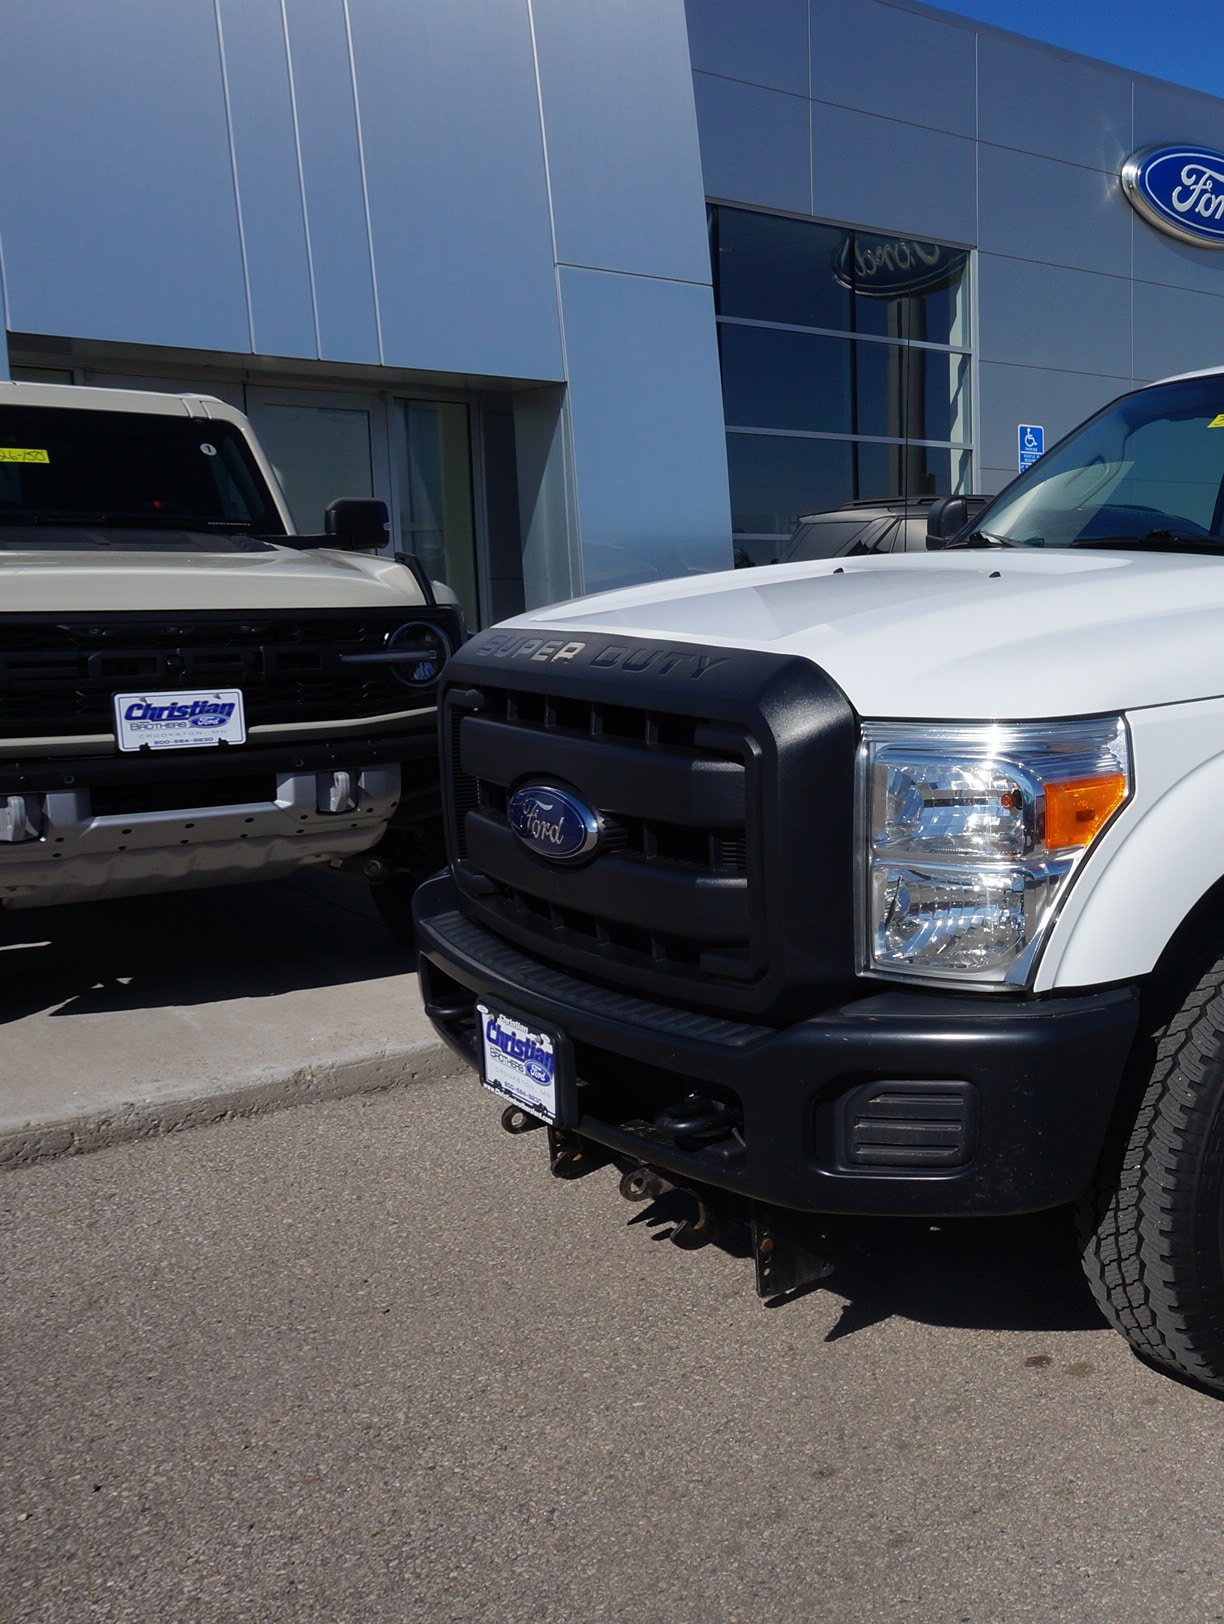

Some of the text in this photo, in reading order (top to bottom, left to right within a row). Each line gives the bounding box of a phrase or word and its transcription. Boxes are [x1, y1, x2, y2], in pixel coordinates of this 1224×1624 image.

[476, 635, 733, 680] SUPER DUTY
[124, 700, 236, 722] Christian
[197, 716, 220, 726] Ford
[130, 721, 187, 731] BROTHERS
[519, 797, 565, 845] Ford
[486, 1019, 555, 1075] Christian
[489, 1046, 524, 1073] BROTHERS
[530, 1064, 547, 1082] Ford
